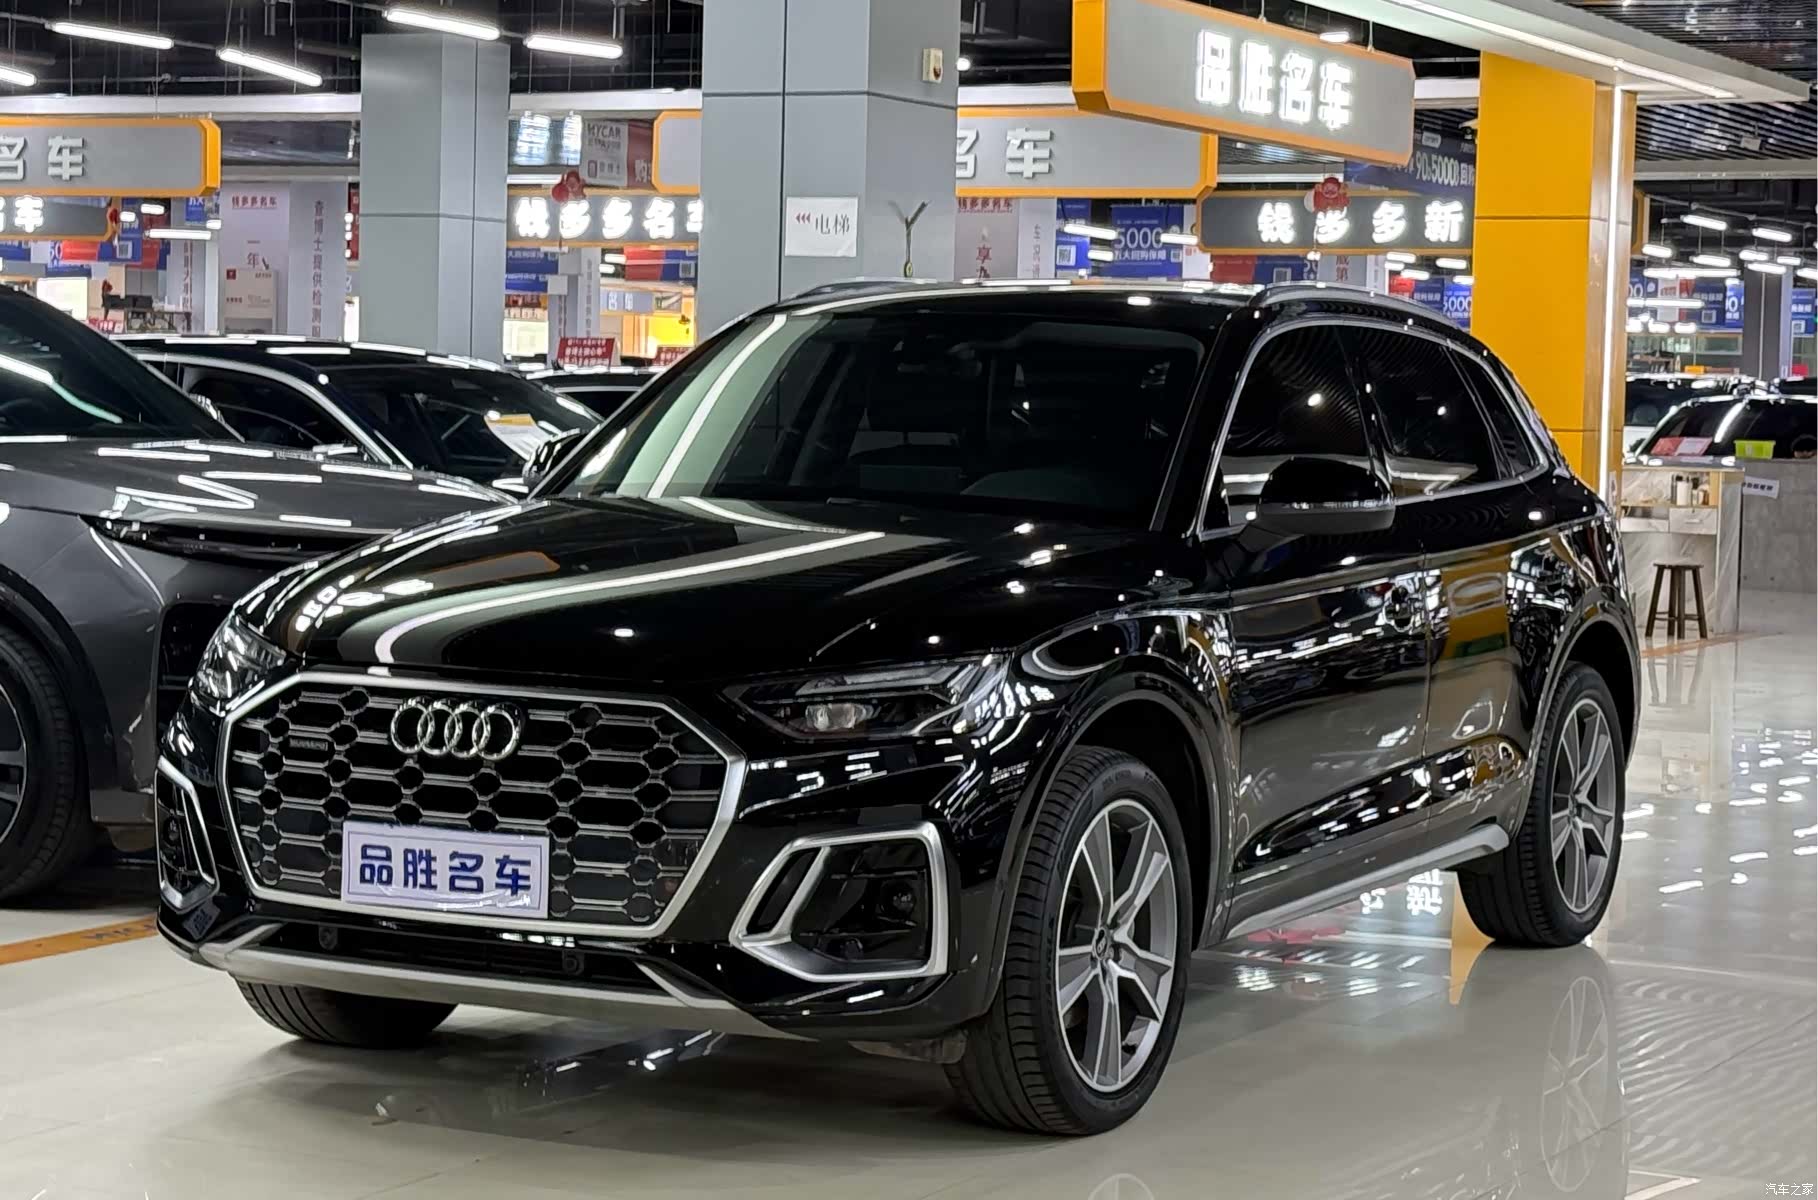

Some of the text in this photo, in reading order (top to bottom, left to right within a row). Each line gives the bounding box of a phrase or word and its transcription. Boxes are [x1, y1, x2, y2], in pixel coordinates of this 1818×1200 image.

[1196, 29, 1352, 130] 品胜名车
[0, 195, 43, 233] 车
[815, 213, 850, 236] 电梯
[360, 844, 531, 896] 品胜名车
